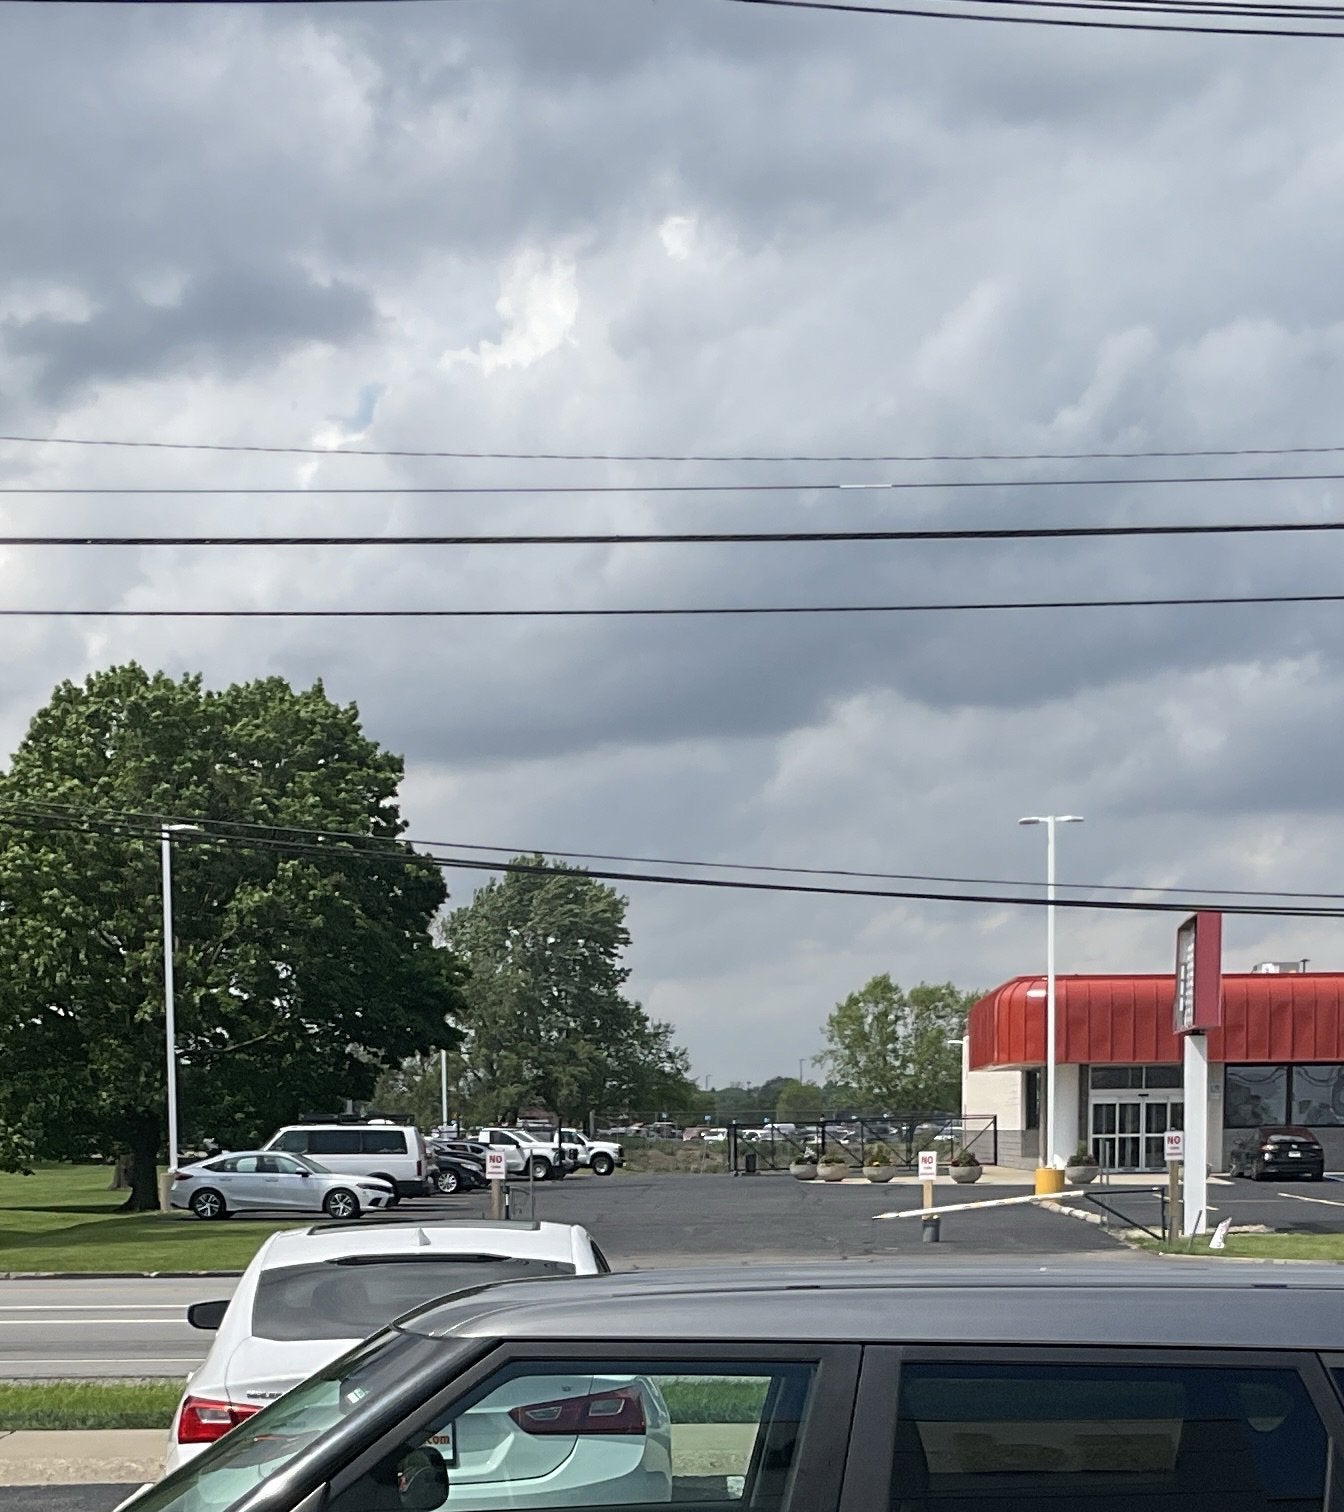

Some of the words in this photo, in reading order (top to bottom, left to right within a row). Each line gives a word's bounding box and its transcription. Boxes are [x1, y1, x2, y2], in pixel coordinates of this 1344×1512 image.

[1167, 1135, 1181, 1145] NO
[488, 1154, 503, 1164] NO
[921, 1155, 934, 1165] NO
